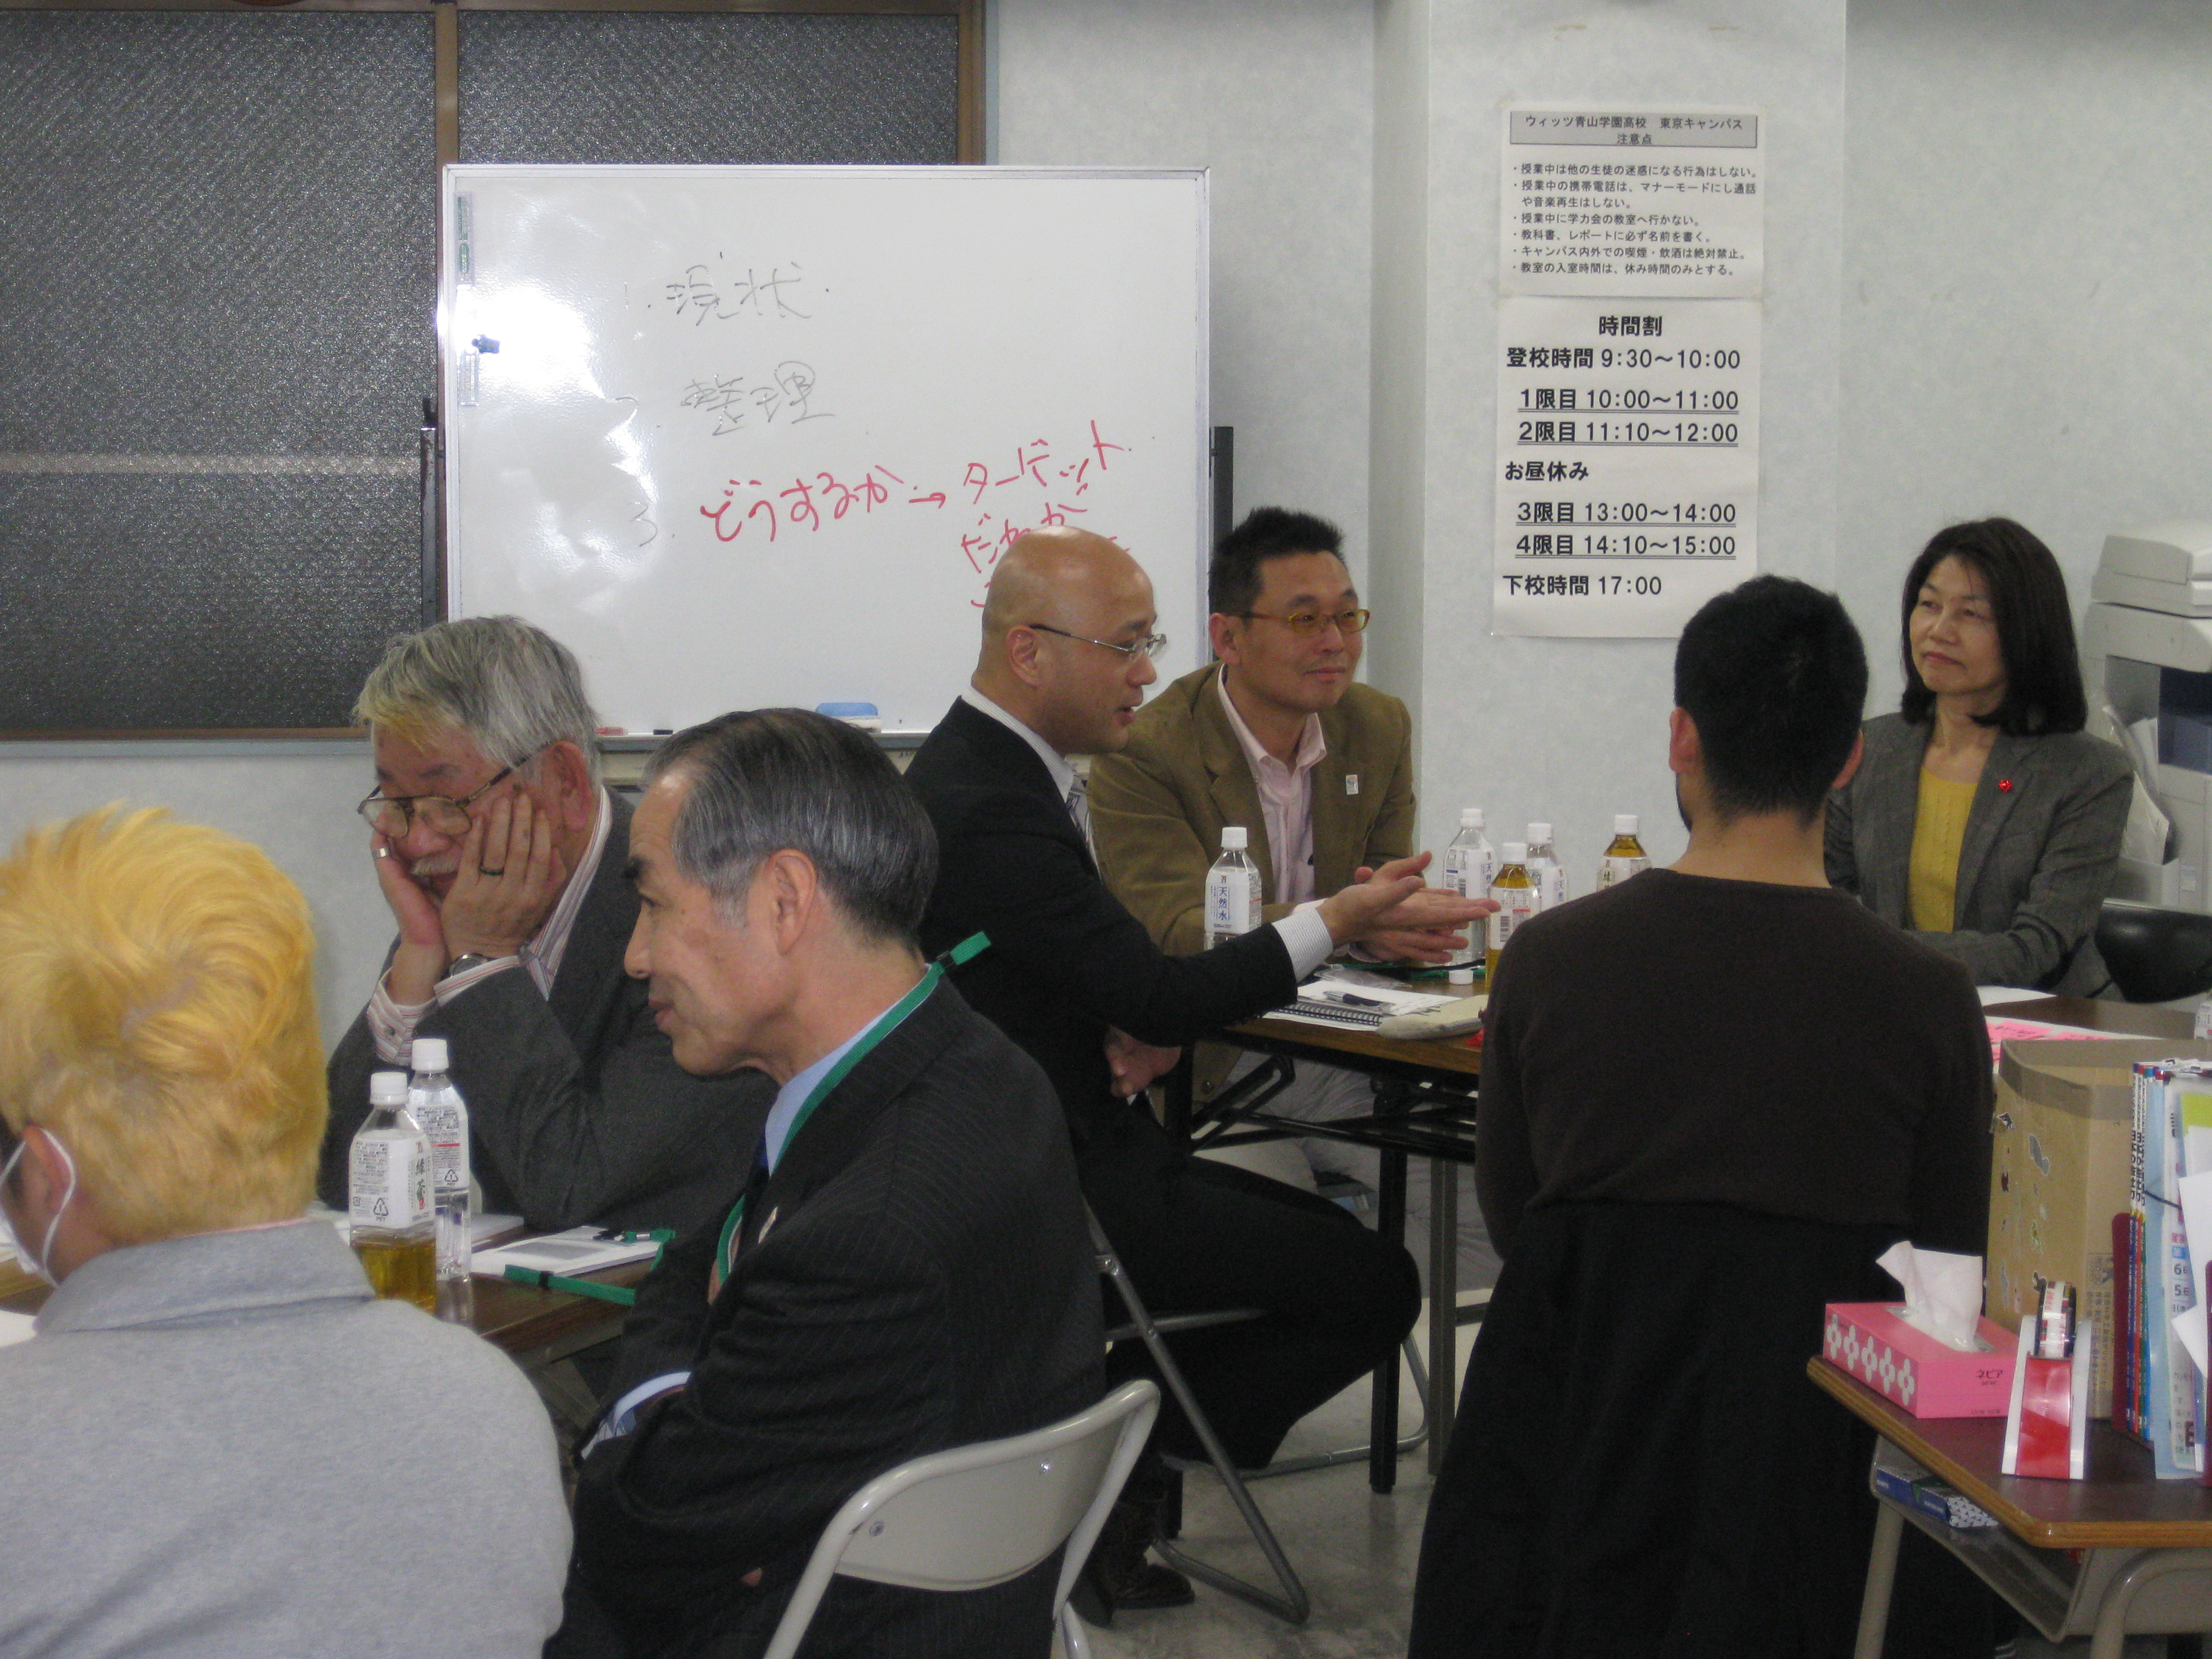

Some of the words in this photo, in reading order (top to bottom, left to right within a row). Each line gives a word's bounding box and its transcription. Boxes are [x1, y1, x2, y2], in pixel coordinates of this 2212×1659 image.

[1525, 115, 1647, 129] ウィッツ青山学園高校
[1660, 117, 1742, 129] 東京キャンパス
[1617, 133, 1652, 146] 注意点
[1522, 196, 1631, 209] や音楽再生はしない。
[1598, 315, 1663, 337] 時間割
[1507, 347, 1594, 369] 登校時間
[680, 361, 836, 435] 整理
[1521, 388, 1576, 409] 1限目
[1519, 421, 1575, 441] 2限目
[1504, 461, 1589, 481] お昼休み
[699, 465, 904, 541] どうするか
[1518, 502, 1575, 523] 3限目
[1516, 535, 1574, 555] 4限目
[1503, 574, 1590, 595] 下校時間
[1598, 576, 1662, 595] 17:00
[1218, 886, 1228, 920] 天然水
